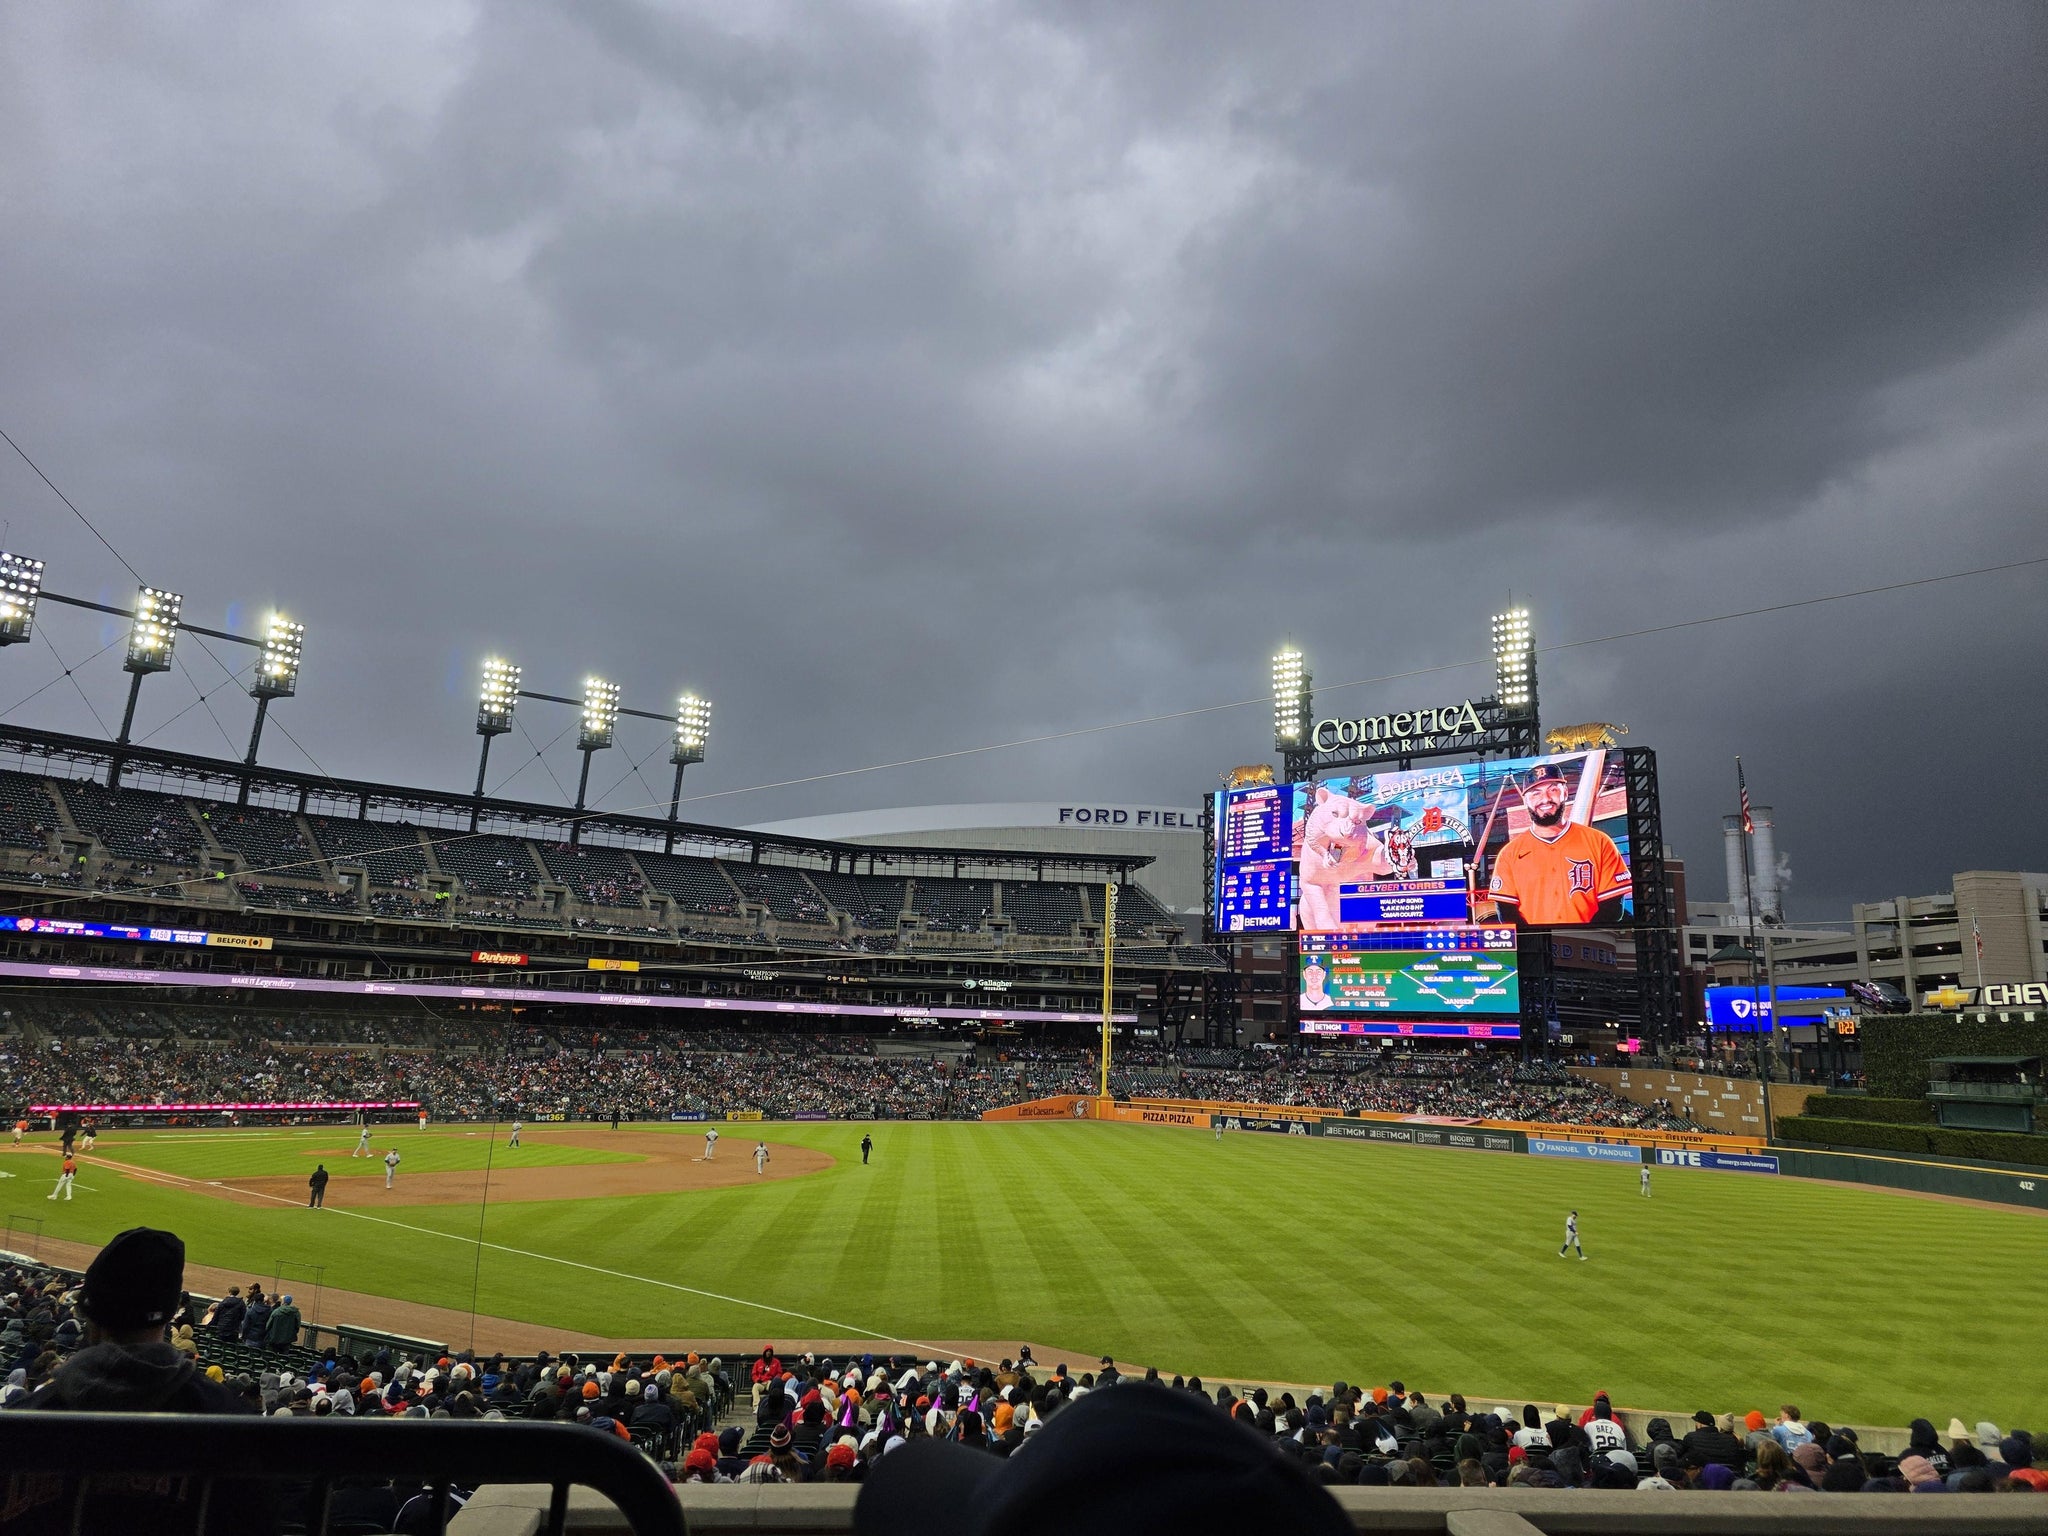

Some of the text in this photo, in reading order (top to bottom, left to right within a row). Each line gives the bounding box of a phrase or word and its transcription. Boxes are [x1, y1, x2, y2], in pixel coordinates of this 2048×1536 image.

[1357, 736, 1438, 757] PARK
[1058, 808, 1128, 824] FORD
[1445, 818, 1471, 844] TIGERS
[1564, 857, 1595, 898] D
[1358, 882, 1446, 892] GLEYBER TORRES
[1110, 896, 1118, 938] Rocket
[1244, 916, 1280, 926] BETMGM
[216, 936, 247, 945] BELFOR
[478, 952, 521, 964] Dunham's
[1310, 955, 1318, 964] T
[743, 970, 780, 978] CHAMPIONS
[232, 977, 250, 985] MAKE
[256, 978, 296, 988] Legendary
[978, 979, 1013, 988] Gallagher
[619, 996, 650, 1004] Legendary
[1314, 1024, 1342, 1032] BETMGM
[1838, 1022, 1856, 1034] 0:23
[1622, 1072, 1628, 1080] 23
[1670, 1074, 1675, 1084] 5
[1698, 1078, 1703, 1087] 2
[1713, 1100, 1718, 1108] 3
[1018, 1106, 1064, 1116] Little Caesars.com
[535, 1113, 566, 1122] bet365
[1142, 1112, 1194, 1124] PIZZA! PIZZA!
[1334, 1127, 1410, 1140] BETMGM BETMGM
[1450, 1134, 1476, 1142] BIGGBY
[1666, 1134, 1704, 1142] DELIVERY
[1546, 1144, 1634, 1158] FANDUEL FANDUEL
[1661, 1150, 1702, 1166] DTE
[1596, 1424, 1614, 1435] BAEZ
[1530, 1436, 1544, 1445] MIZE
[1596, 1435, 1618, 1448] 28
